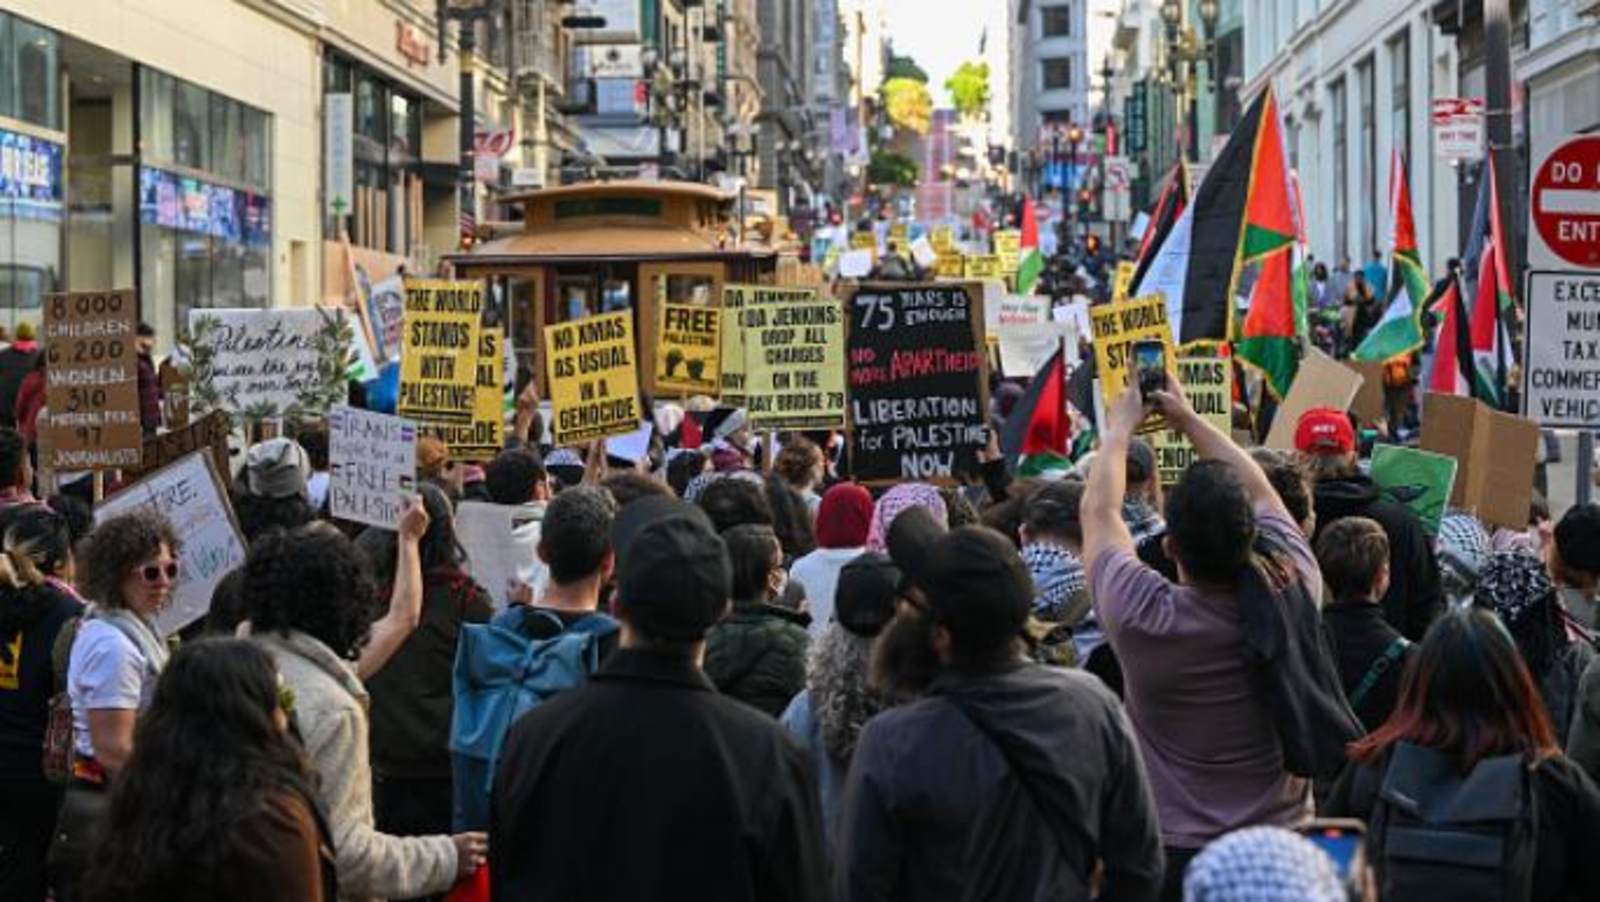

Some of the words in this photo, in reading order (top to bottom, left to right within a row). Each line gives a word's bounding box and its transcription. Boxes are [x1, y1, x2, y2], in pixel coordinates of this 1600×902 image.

[1551, 163, 1582, 183] DO
[1558, 221, 1600, 241] ENT
[407, 289, 430, 311] THE
[434, 289, 480, 312] WORLD
[856, 295, 895, 330] 75
[900, 291, 943, 307] YEARS
[952, 291, 967, 307] IS
[665, 308, 718, 333] FREE
[746, 308, 767, 327] DA
[772, 306, 841, 326] JENKINS:
[904, 307, 966, 326] ENOUGH
[1093, 314, 1119, 338] THE
[1121, 303, 1166, 333] WORLD
[1567, 311, 1600, 330] MU
[411, 321, 469, 348] STANDS
[553, 327, 573, 351] NO
[578, 317, 626, 346] XMAS
[761, 329, 795, 346] DROP
[805, 328, 827, 344] ALL
[420, 356, 455, 379] WITH
[555, 357, 575, 378] AS
[579, 346, 631, 373] USUAL
[765, 347, 824, 365] CHARGES
[851, 348, 875, 364] NO
[891, 346, 987, 381] APARTHEID
[50, 366, 126, 386] WOMEN
[773, 373, 790, 389] ON
[794, 371, 817, 388] THE
[580, 383, 594, 401] IN
[598, 379, 609, 397] A
[559, 397, 636, 430] GENOCIDE
[778, 393, 822, 411] BRIDGE
[854, 396, 977, 425] LIBERATION
[859, 429, 883, 449] for
[893, 425, 989, 449] PALESTINE
[902, 452, 954, 478] NOW
